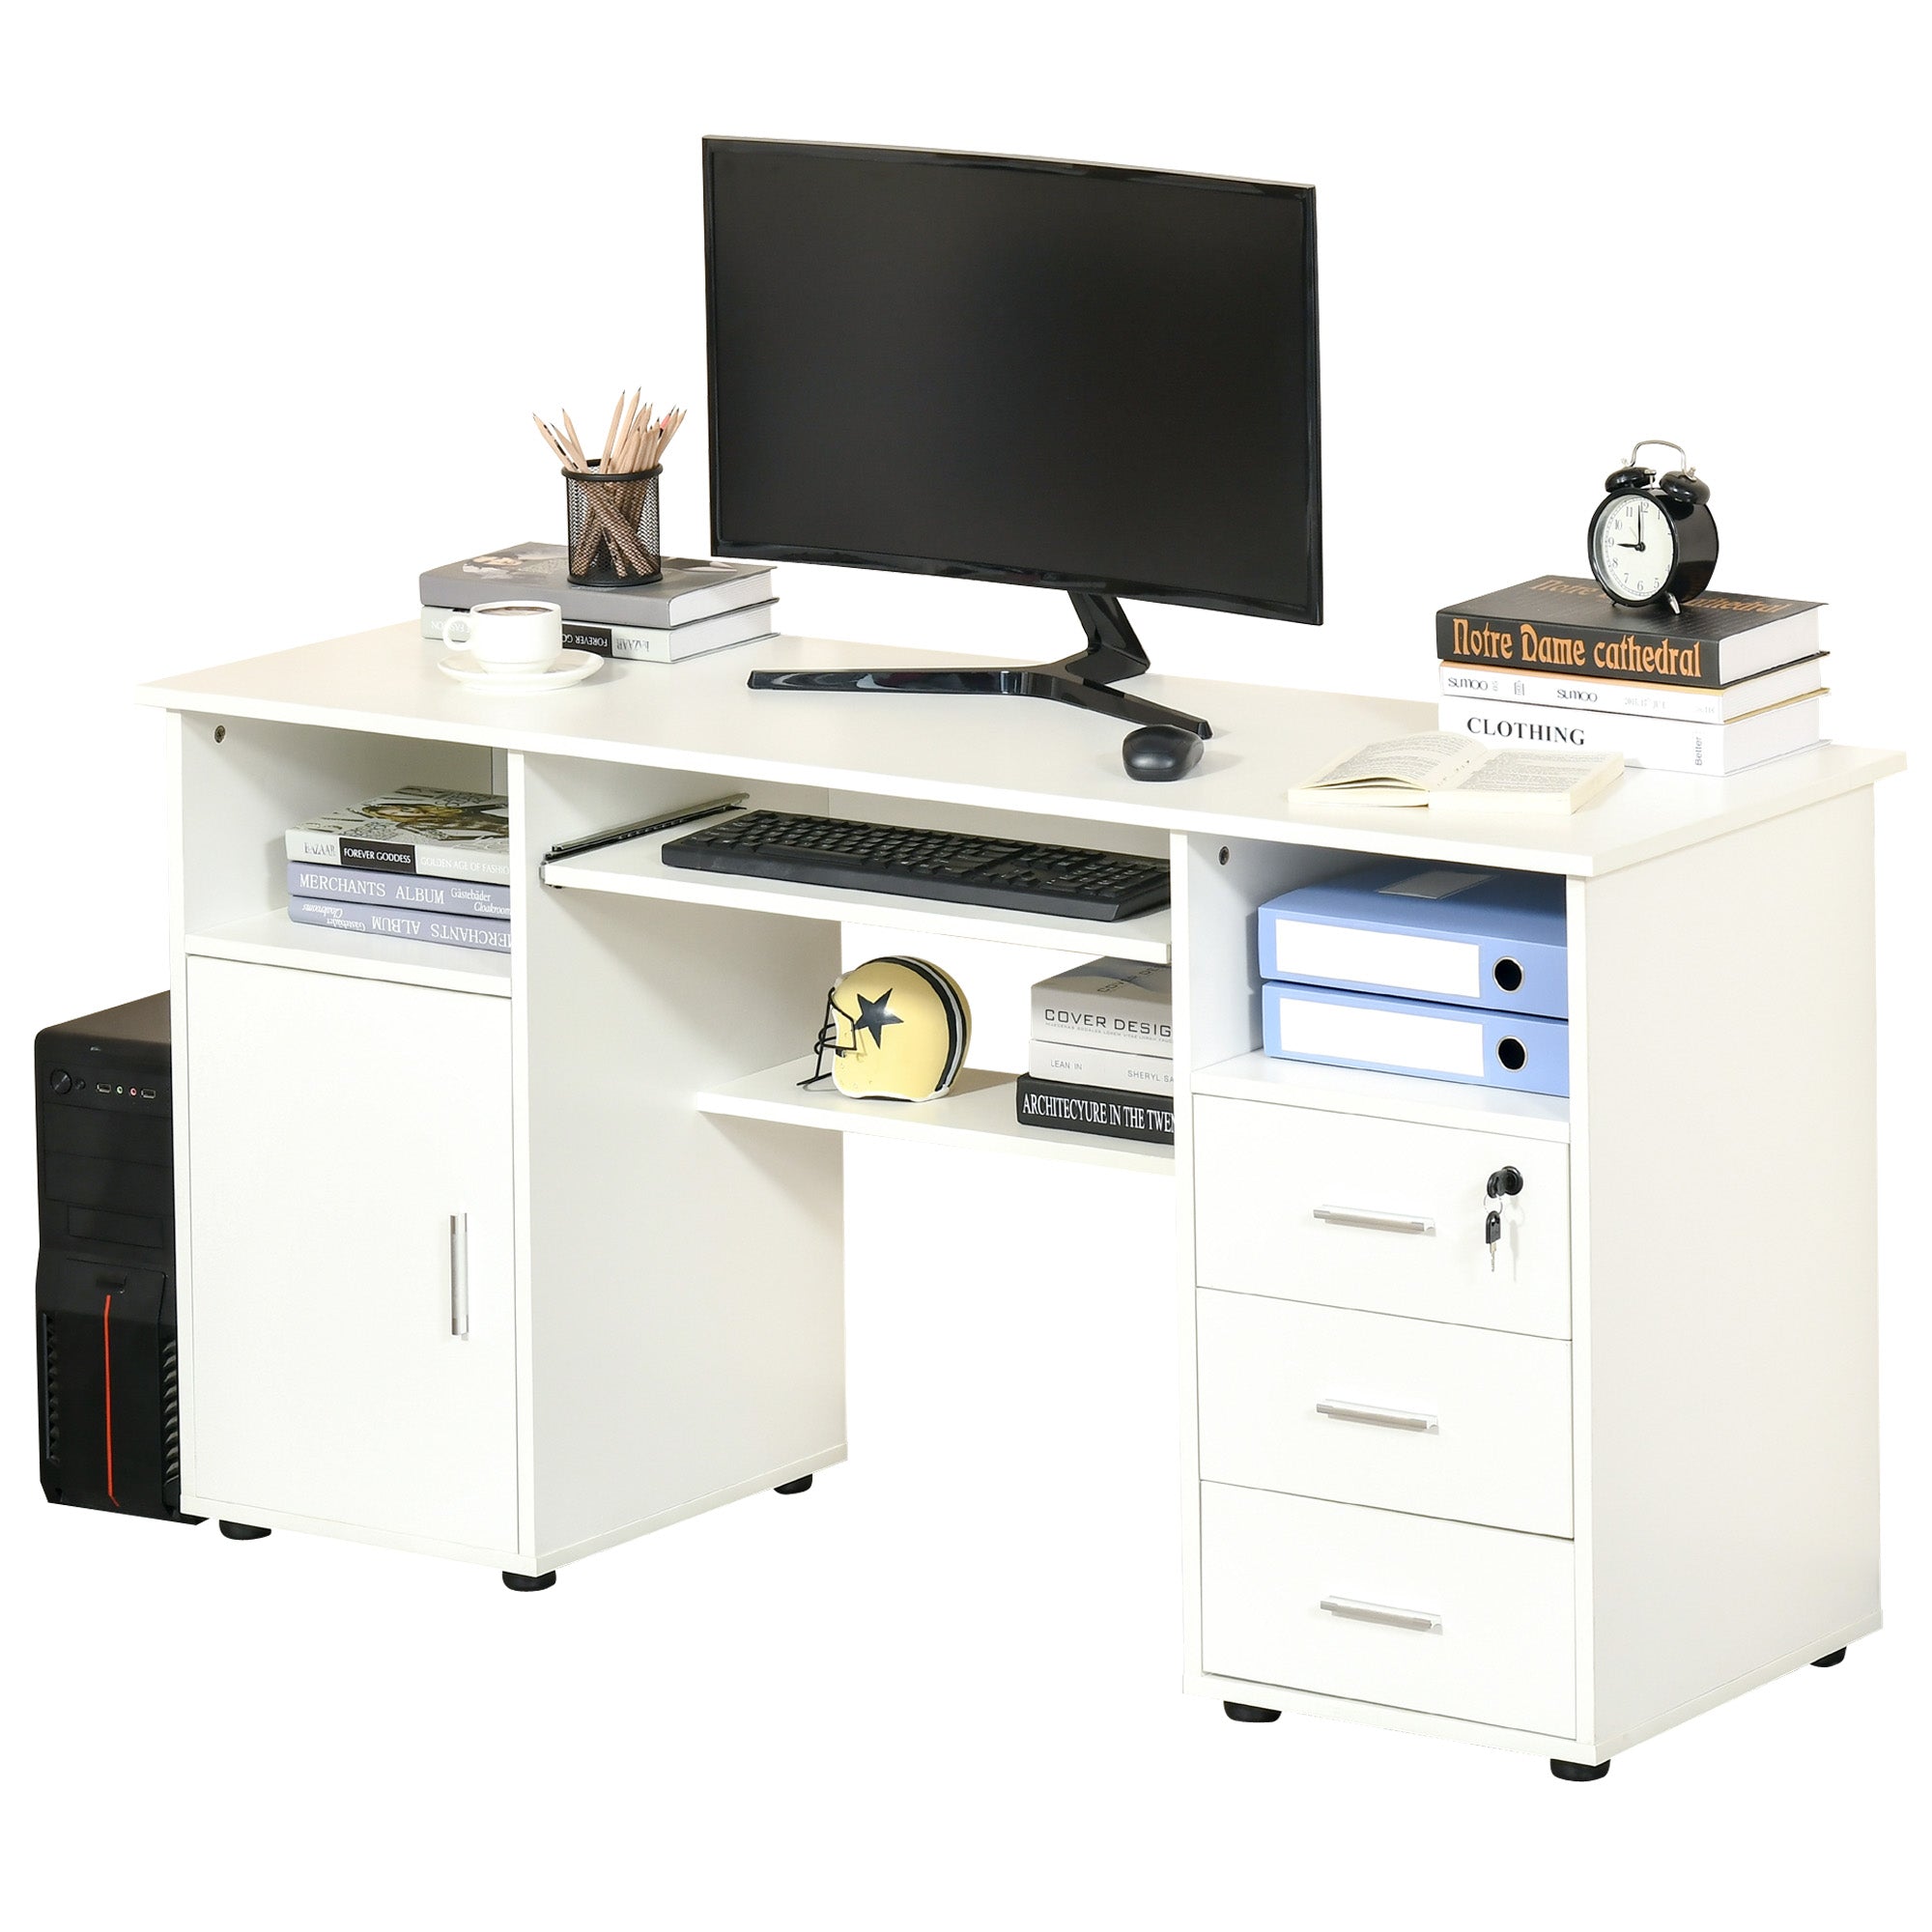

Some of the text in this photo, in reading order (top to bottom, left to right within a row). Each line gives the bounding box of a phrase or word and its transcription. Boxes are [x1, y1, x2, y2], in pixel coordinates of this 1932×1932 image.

[1626, 506, 1634, 518] 11
[1614, 519, 1623, 530] 10
[1607, 537, 1615, 548] 9
[1612, 557, 1619, 569] 8
[1624, 573, 1630, 583] 7
[1653, 578, 1660, 589] 5
[1636, 581, 1644, 591] 6
[1681, 597, 1794, 613] athedral
[575, 635, 609, 647] FOREVER
[1452, 617, 1702, 678] Notre Dame cathedral
[1466, 717, 1585, 746] CLOTHING
[1694, 736, 1703, 766] Better
[343, 847, 375, 860] FOREVER
[376, 852, 412, 864] GODDESS
[420, 857, 452, 867] GOLDEN
[452, 860, 468, 869] AGE
[299, 873, 386, 897] MERCHANTS
[395, 885, 444, 905] ALBUM
[372, 916, 420, 935] ALBUM
[1045, 1009, 1172, 1037] COVER DESIG
[1050, 1060, 1070, 1070] LEAN
[1127, 1069, 1161, 1082] SHERYL
[1022, 1093, 1108, 1124] ARCHITECYURE
[1109, 1104, 1122, 1126] IN
[1122, 1106, 1146, 1130] THE
